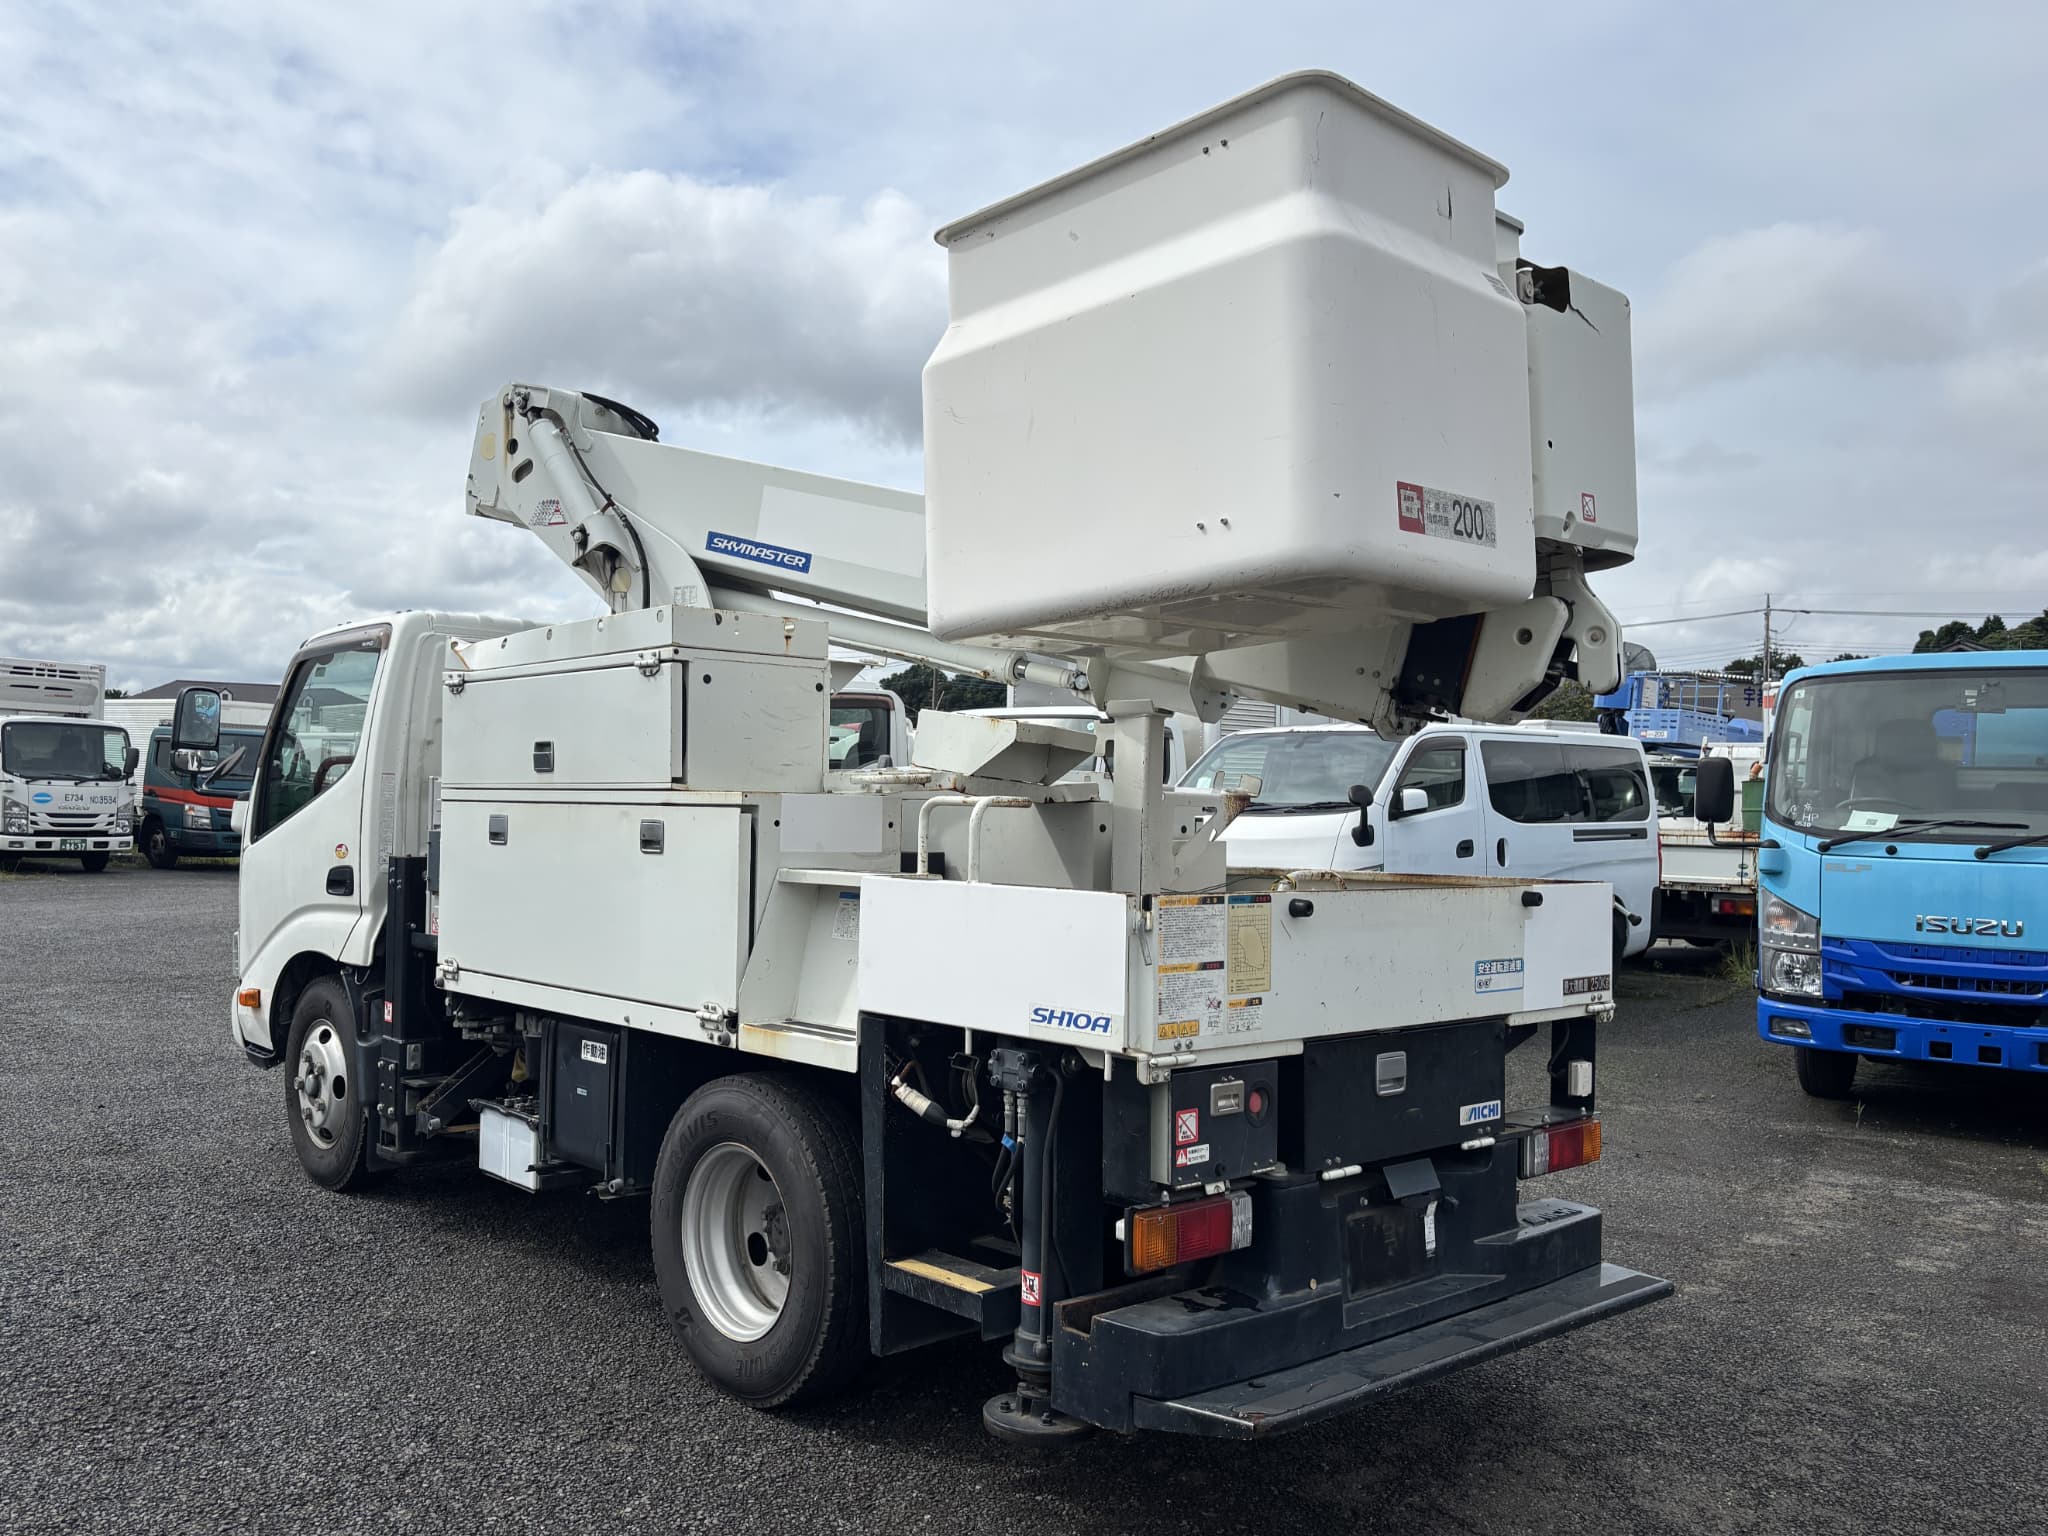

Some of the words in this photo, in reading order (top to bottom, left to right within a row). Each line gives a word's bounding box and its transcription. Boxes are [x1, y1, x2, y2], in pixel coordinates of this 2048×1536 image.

[1453, 500, 1484, 541] 200
[711, 537, 806, 567] SKYMASTER
[65, 793, 84, 802] E734
[1916, 914, 2024, 938] ISUZU
[1030, 1007, 1111, 1033] SH10A
[1468, 1103, 1499, 1121] AICHI
